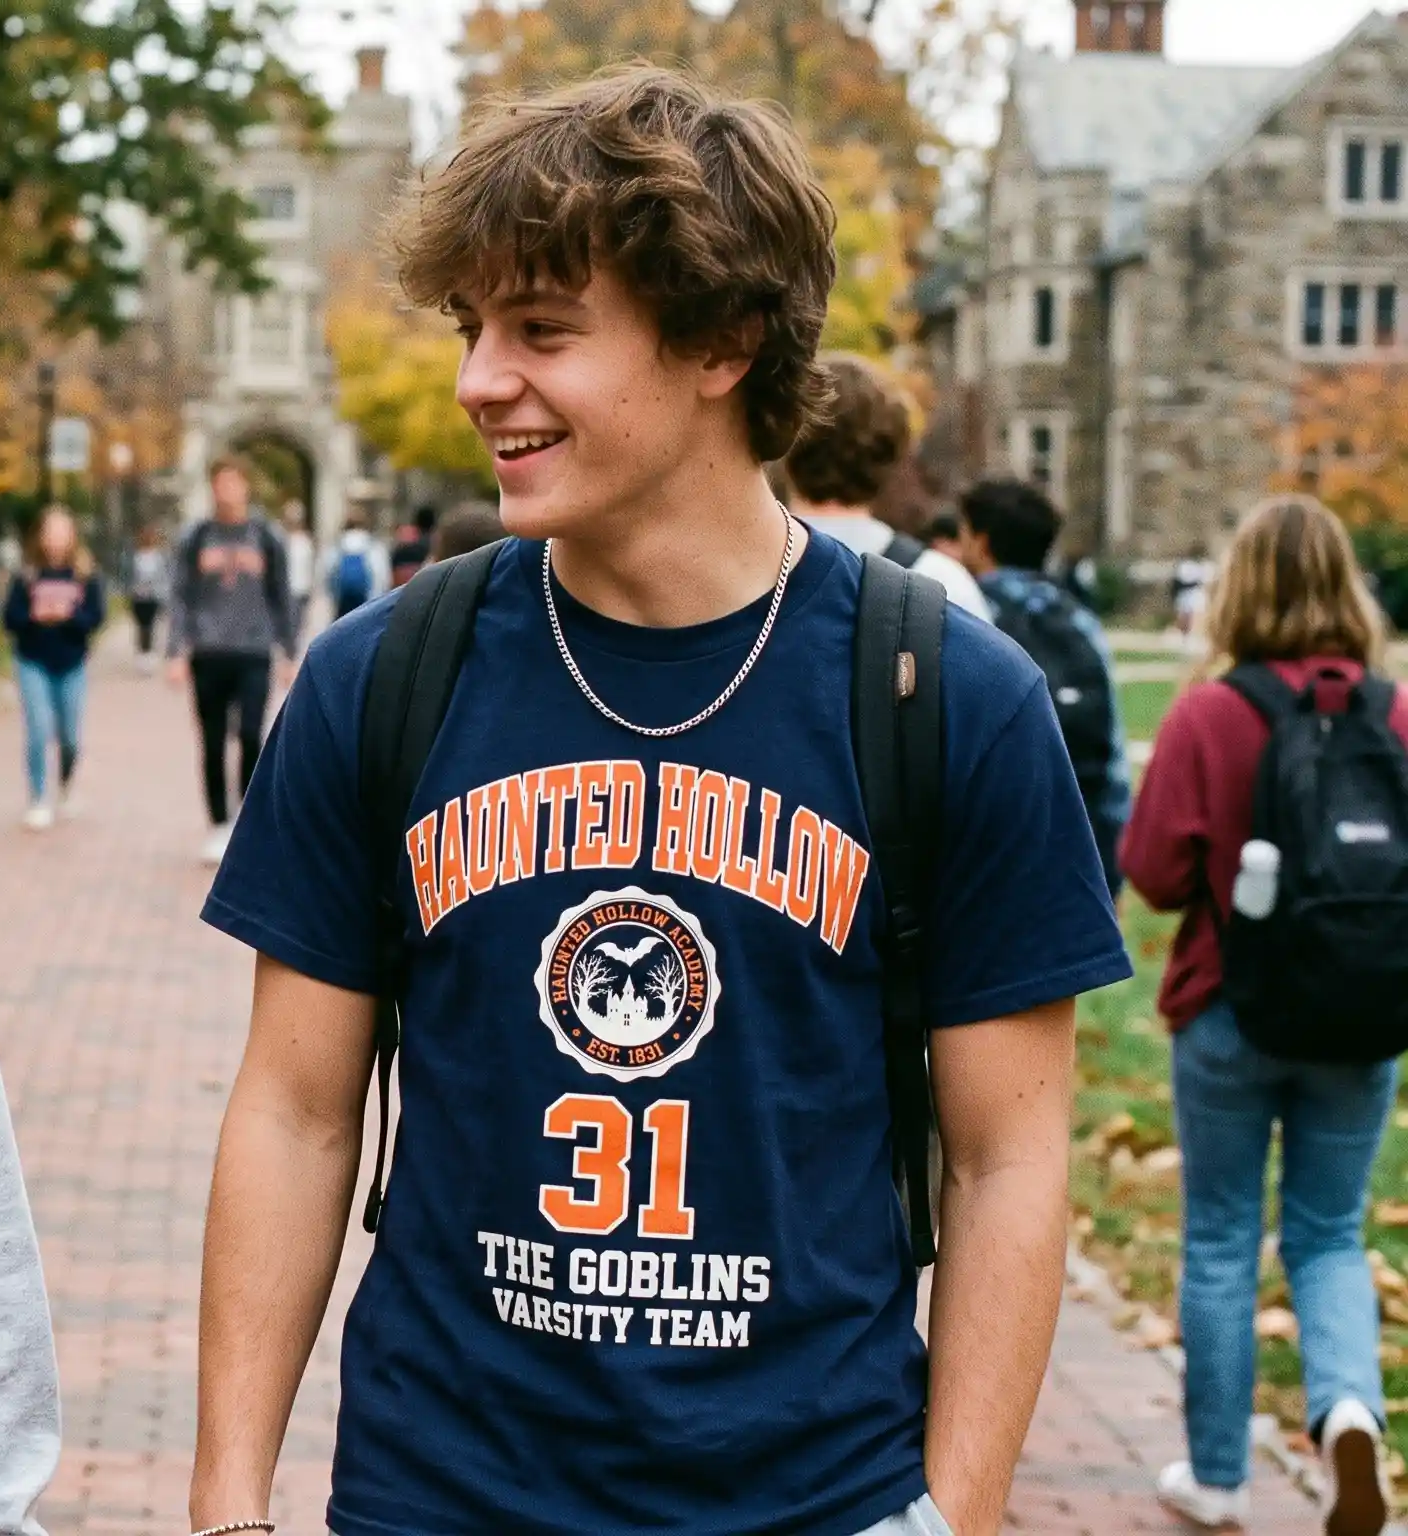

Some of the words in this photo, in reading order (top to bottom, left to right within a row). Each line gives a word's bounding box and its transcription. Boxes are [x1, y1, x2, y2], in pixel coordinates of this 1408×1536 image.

[405, 760, 645, 936] HAUNTED
[652, 761, 870, 955] HOLLOW
[551, 920, 591, 1003] HAUNTED
[592, 904, 669, 927] HOLLOW
[669, 926, 706, 1012] ACADEMY
[586, 1037, 620, 1063] EST.
[628, 1042, 664, 1064] 1831
[539, 1092, 694, 1240] 31
[477, 1231, 554, 1290] THE
[569, 1248, 771, 1302] GOBLINS
[492, 1287, 633, 1344] VARSITY
[645, 1308, 750, 1347] TEAM
